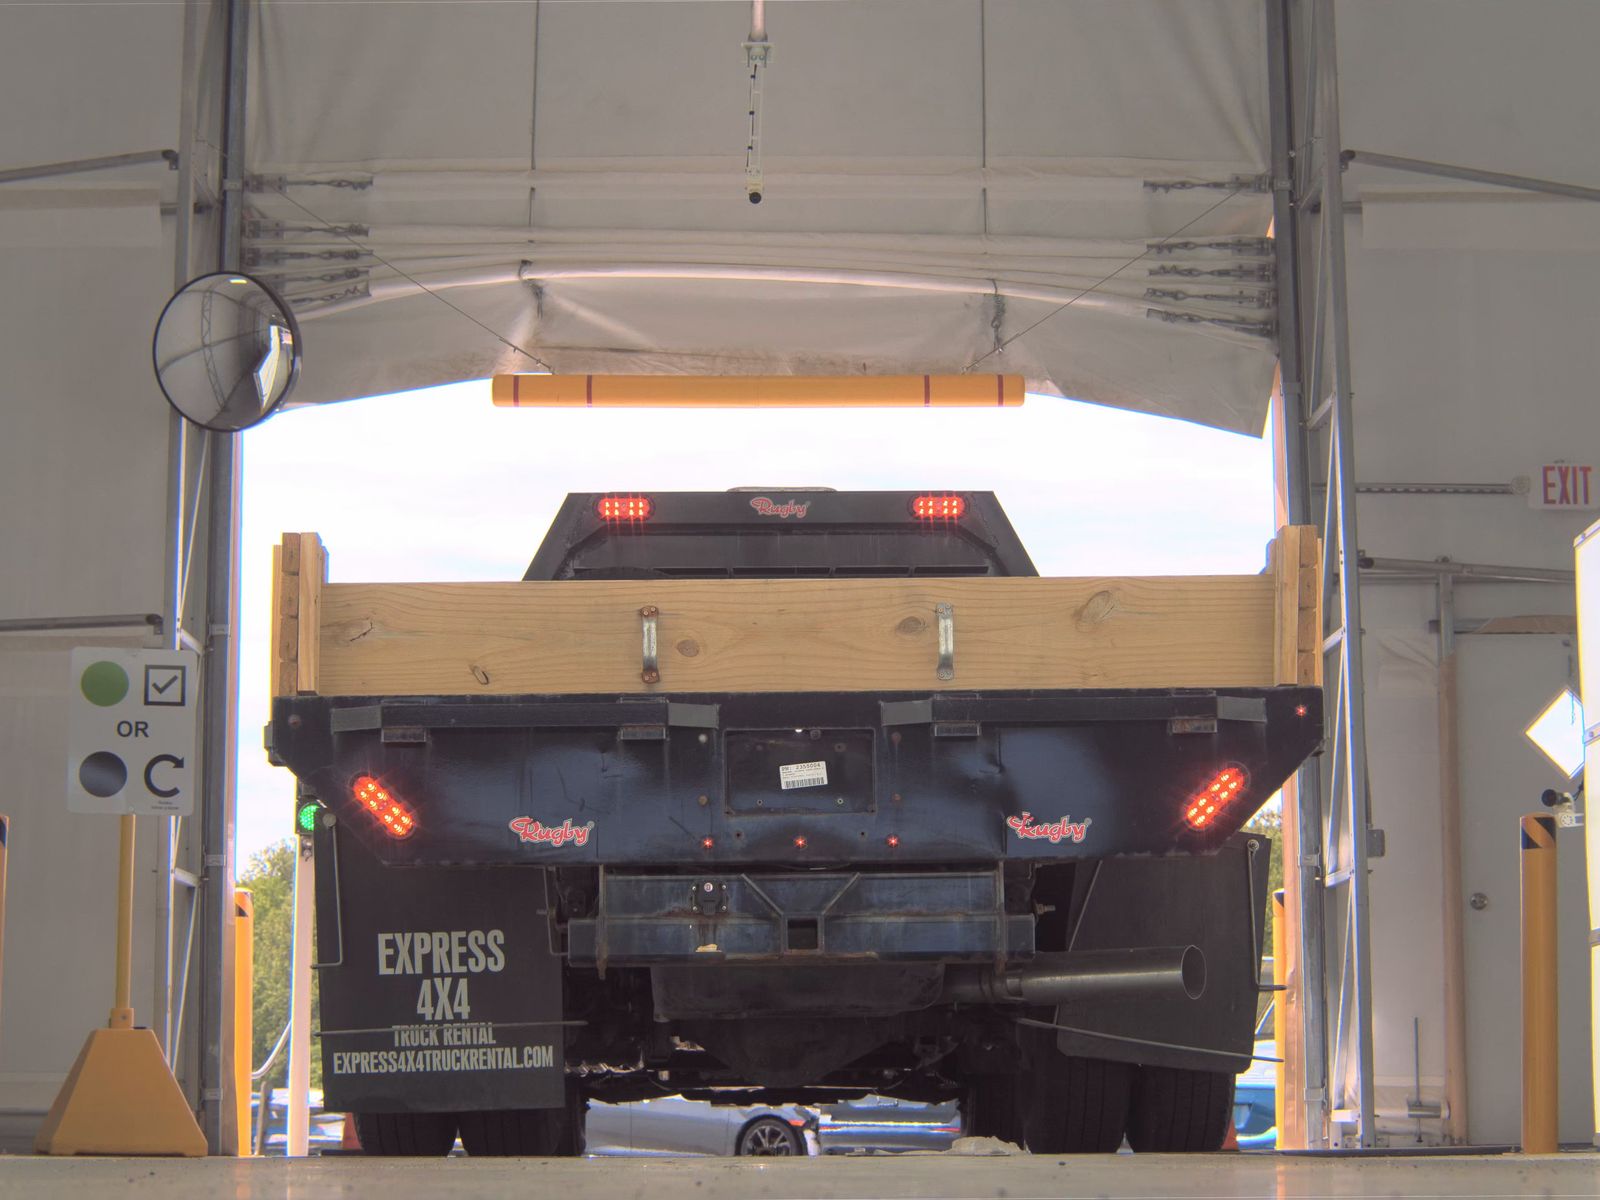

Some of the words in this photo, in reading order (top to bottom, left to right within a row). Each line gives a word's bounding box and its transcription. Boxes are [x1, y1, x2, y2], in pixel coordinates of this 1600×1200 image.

[1543, 465, 1592, 505] EXIT
[750, 497, 808, 519] Rugby
[117, 720, 149, 738] OR
[509, 816, 591, 848] Rugby
[378, 929, 506, 975] EXPRESS
[416, 976, 471, 1021] 4X4
[392, 1025, 440, 1047] TRUCK
[443, 1022, 497, 1046] RENTAL
[333, 1045, 554, 1075] EXPRESS4X4TRUCKRENTAL.COM
